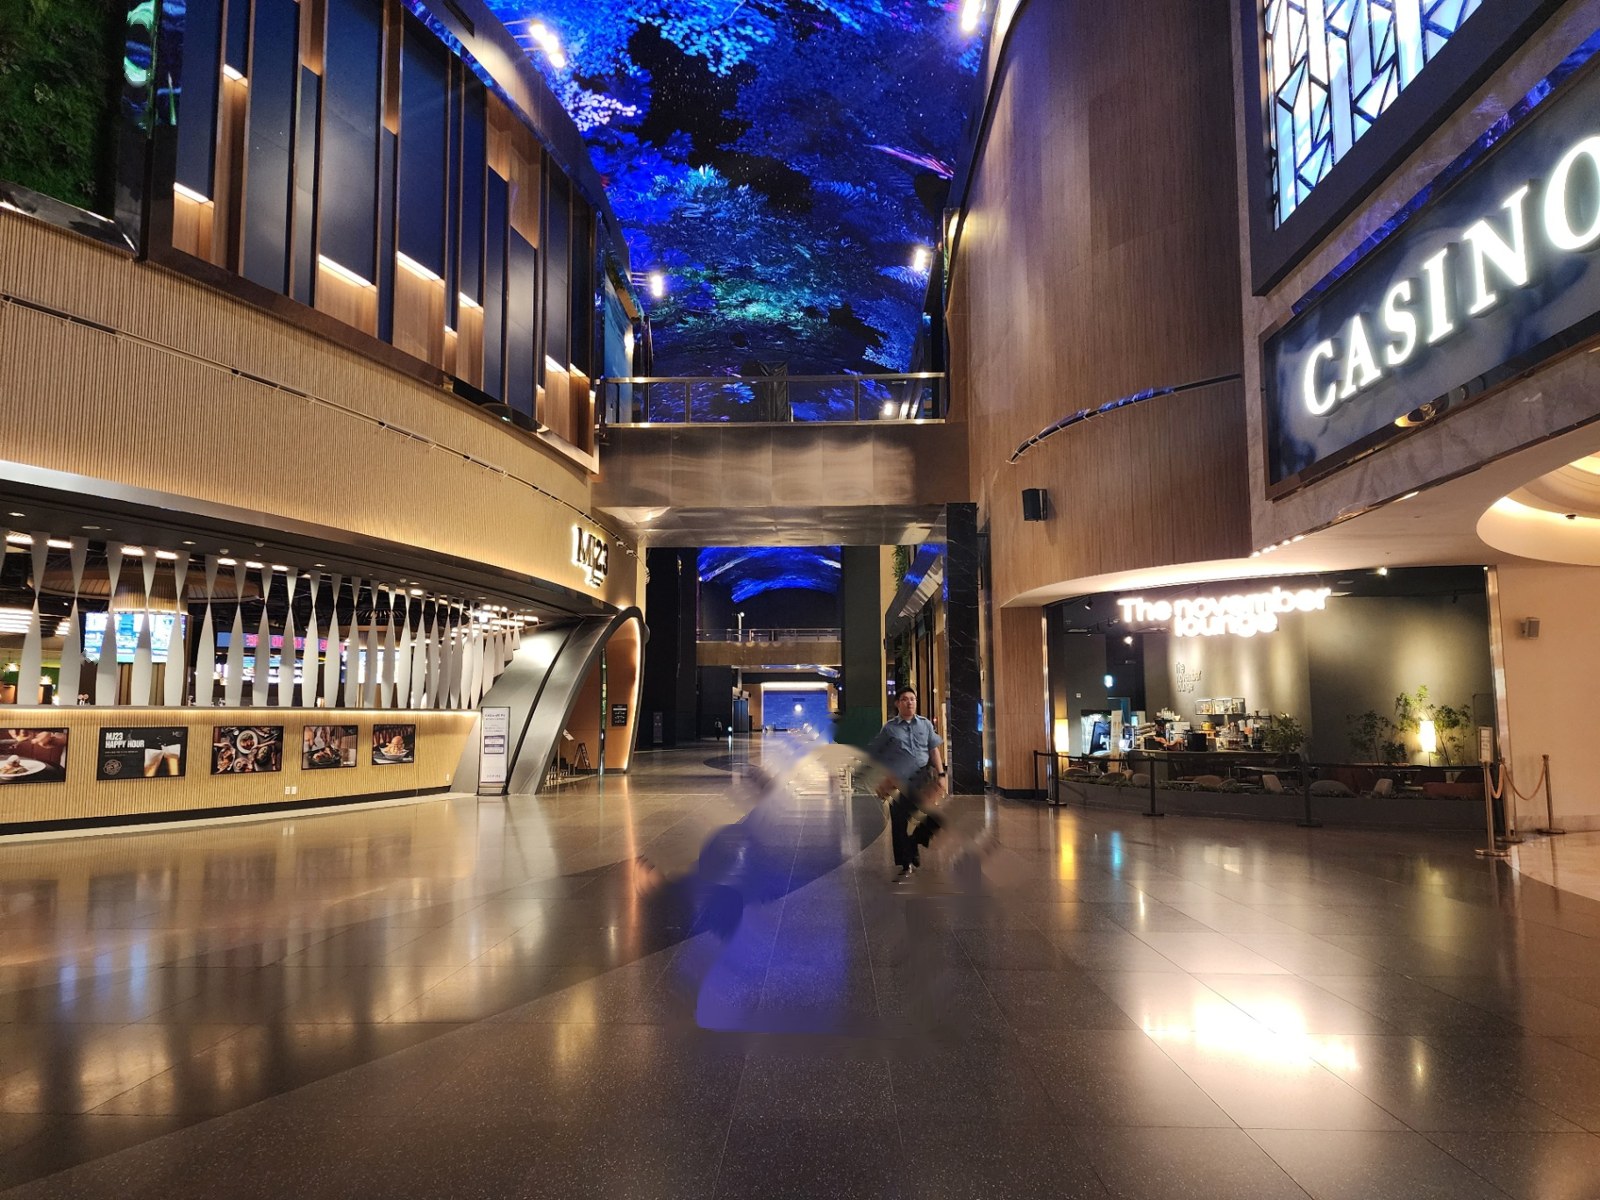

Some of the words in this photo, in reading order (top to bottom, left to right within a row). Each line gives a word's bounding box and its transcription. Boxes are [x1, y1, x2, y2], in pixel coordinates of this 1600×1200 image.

[1303, 135, 1600, 418] CASINO
[1117, 597, 1172, 622] The
[1173, 586, 1332, 619] november
[1173, 611, 1278, 637] lounge
[105, 740, 127, 749] HAPPY
[127, 739, 145, 748] HOUR
